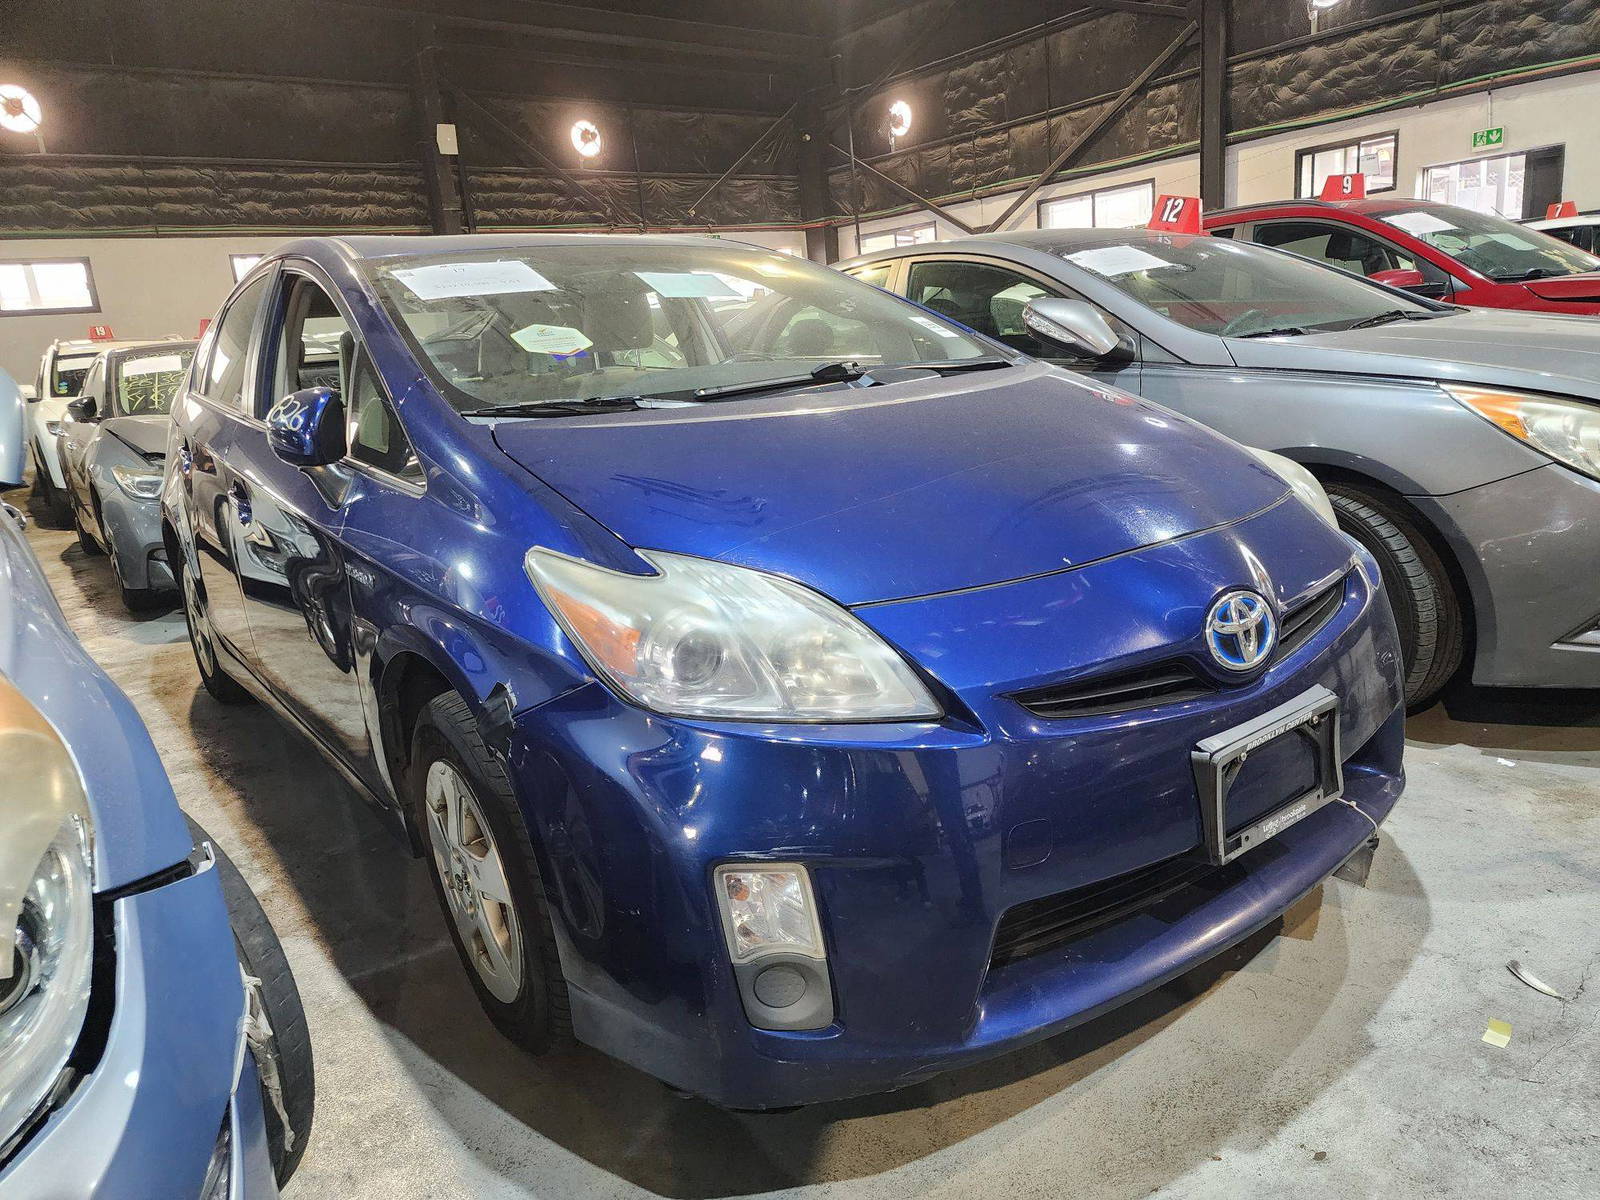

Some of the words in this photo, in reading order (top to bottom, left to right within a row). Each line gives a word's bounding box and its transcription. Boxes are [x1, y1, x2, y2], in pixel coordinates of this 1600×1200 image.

[1342, 175, 1352, 194] 9
[1161, 197, 1186, 223] 12
[1555, 203, 1563, 218] 7
[95, 326, 106, 336] 19
[266, 395, 309, 432] 826
[1246, 725, 1286, 751] BROOKLYN
[1285, 711, 1313, 731] CENTER
